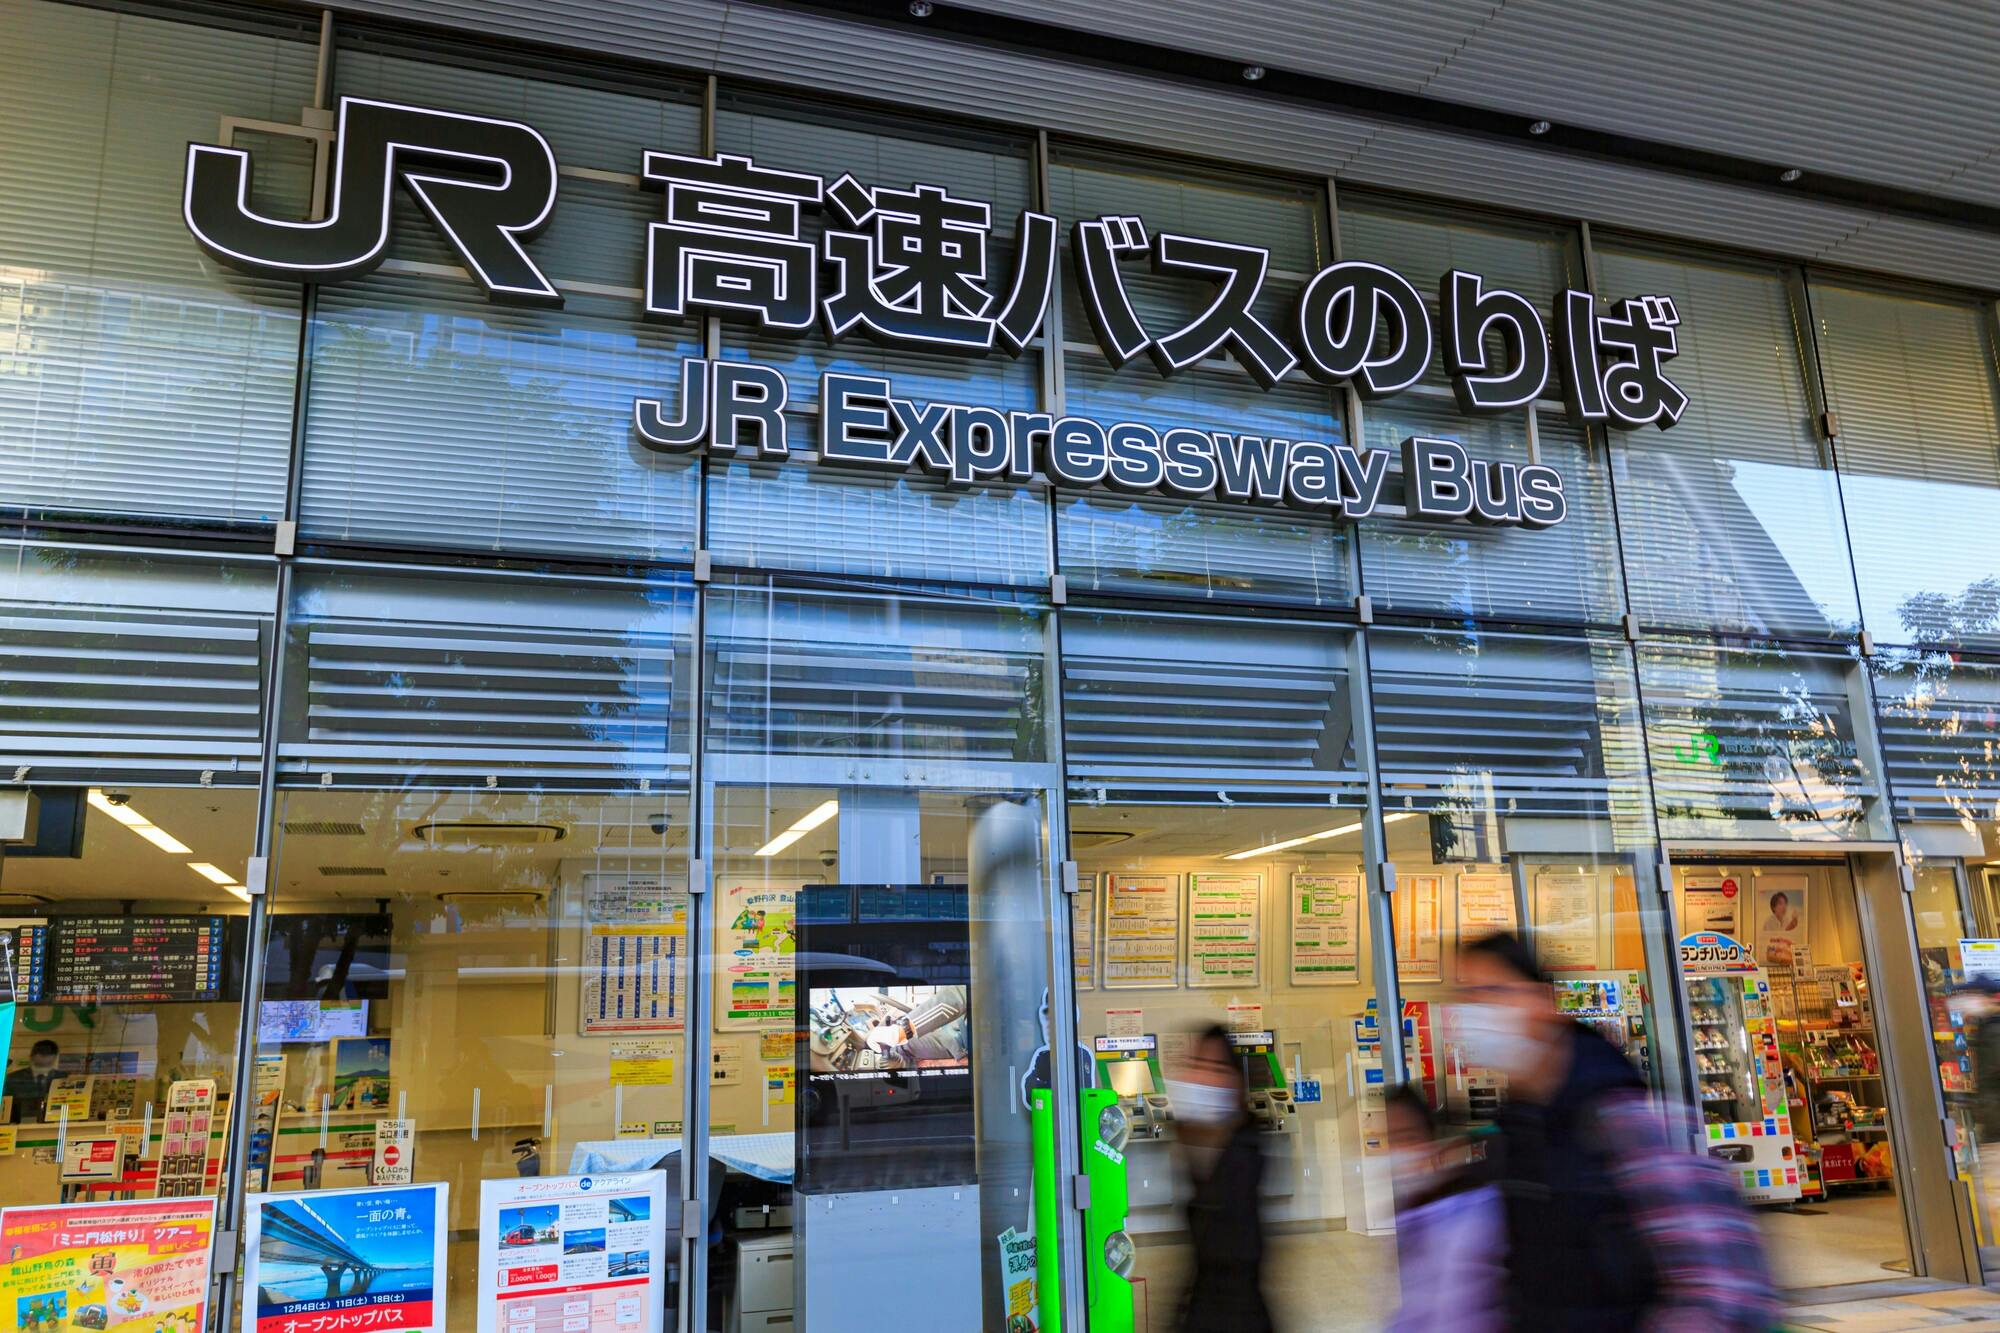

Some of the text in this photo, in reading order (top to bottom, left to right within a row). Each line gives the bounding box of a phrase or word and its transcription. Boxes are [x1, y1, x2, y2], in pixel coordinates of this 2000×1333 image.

[184, 95, 1691, 430] JR 高速バスのりば
[632, 355, 1568, 528] JR Expressway Bus
[1681, 946, 1738, 962] ランチパック
[387, 1166, 409, 1174] 入口から
[519, 1179, 578, 1193] オープントップバス
[580, 1178, 592, 1190] de
[355, 1207, 412, 1223] 一面の青。
[153, 1227, 193, 1241] ツアー
[90, 1251, 117, 1277] 寅
[132, 1256, 205, 1279] 渚の駅たてやま
[283, 1293, 405, 1314] 12月4日(土) 11日(土) 18日(土)
[283, 1308, 404, 1333] オープントップバス
